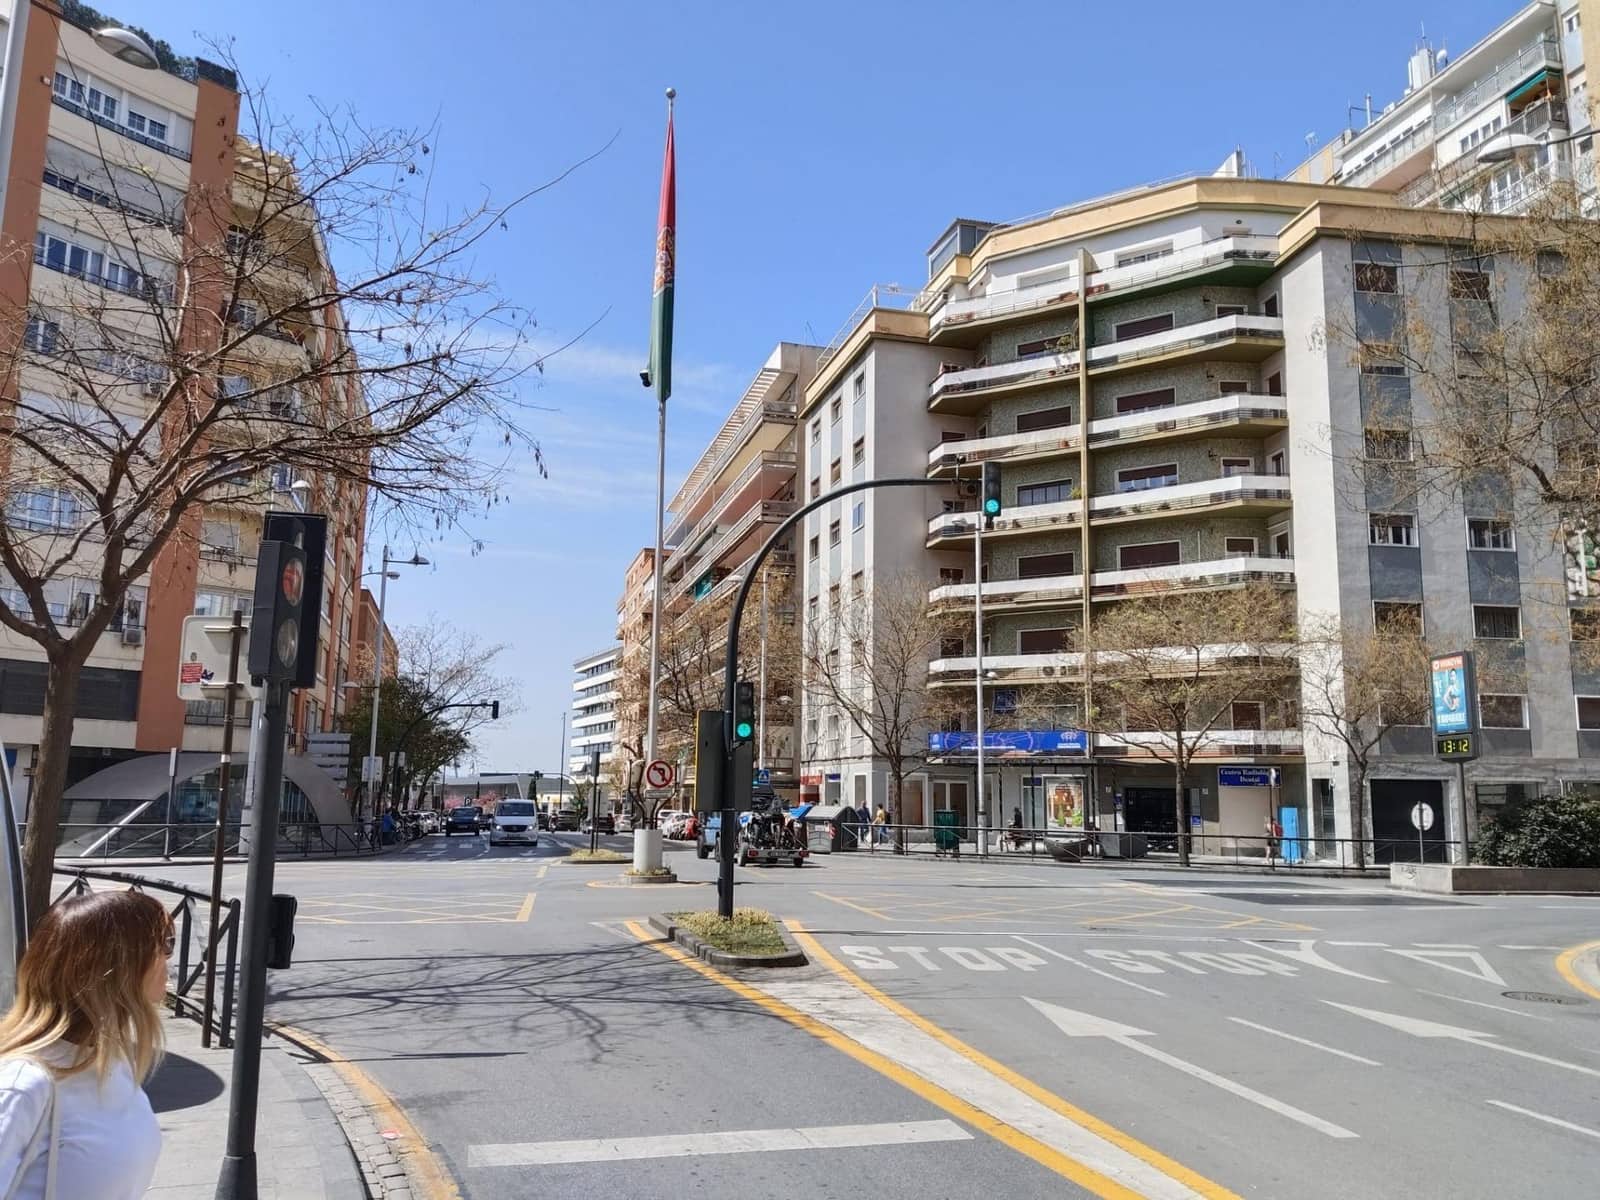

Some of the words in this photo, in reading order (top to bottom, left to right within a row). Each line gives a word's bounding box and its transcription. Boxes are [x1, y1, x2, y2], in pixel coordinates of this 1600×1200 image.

[1442, 739, 1469, 753] 13:12
[839, 945, 1049, 971] STOP
[1082, 949, 1300, 977] STOP
